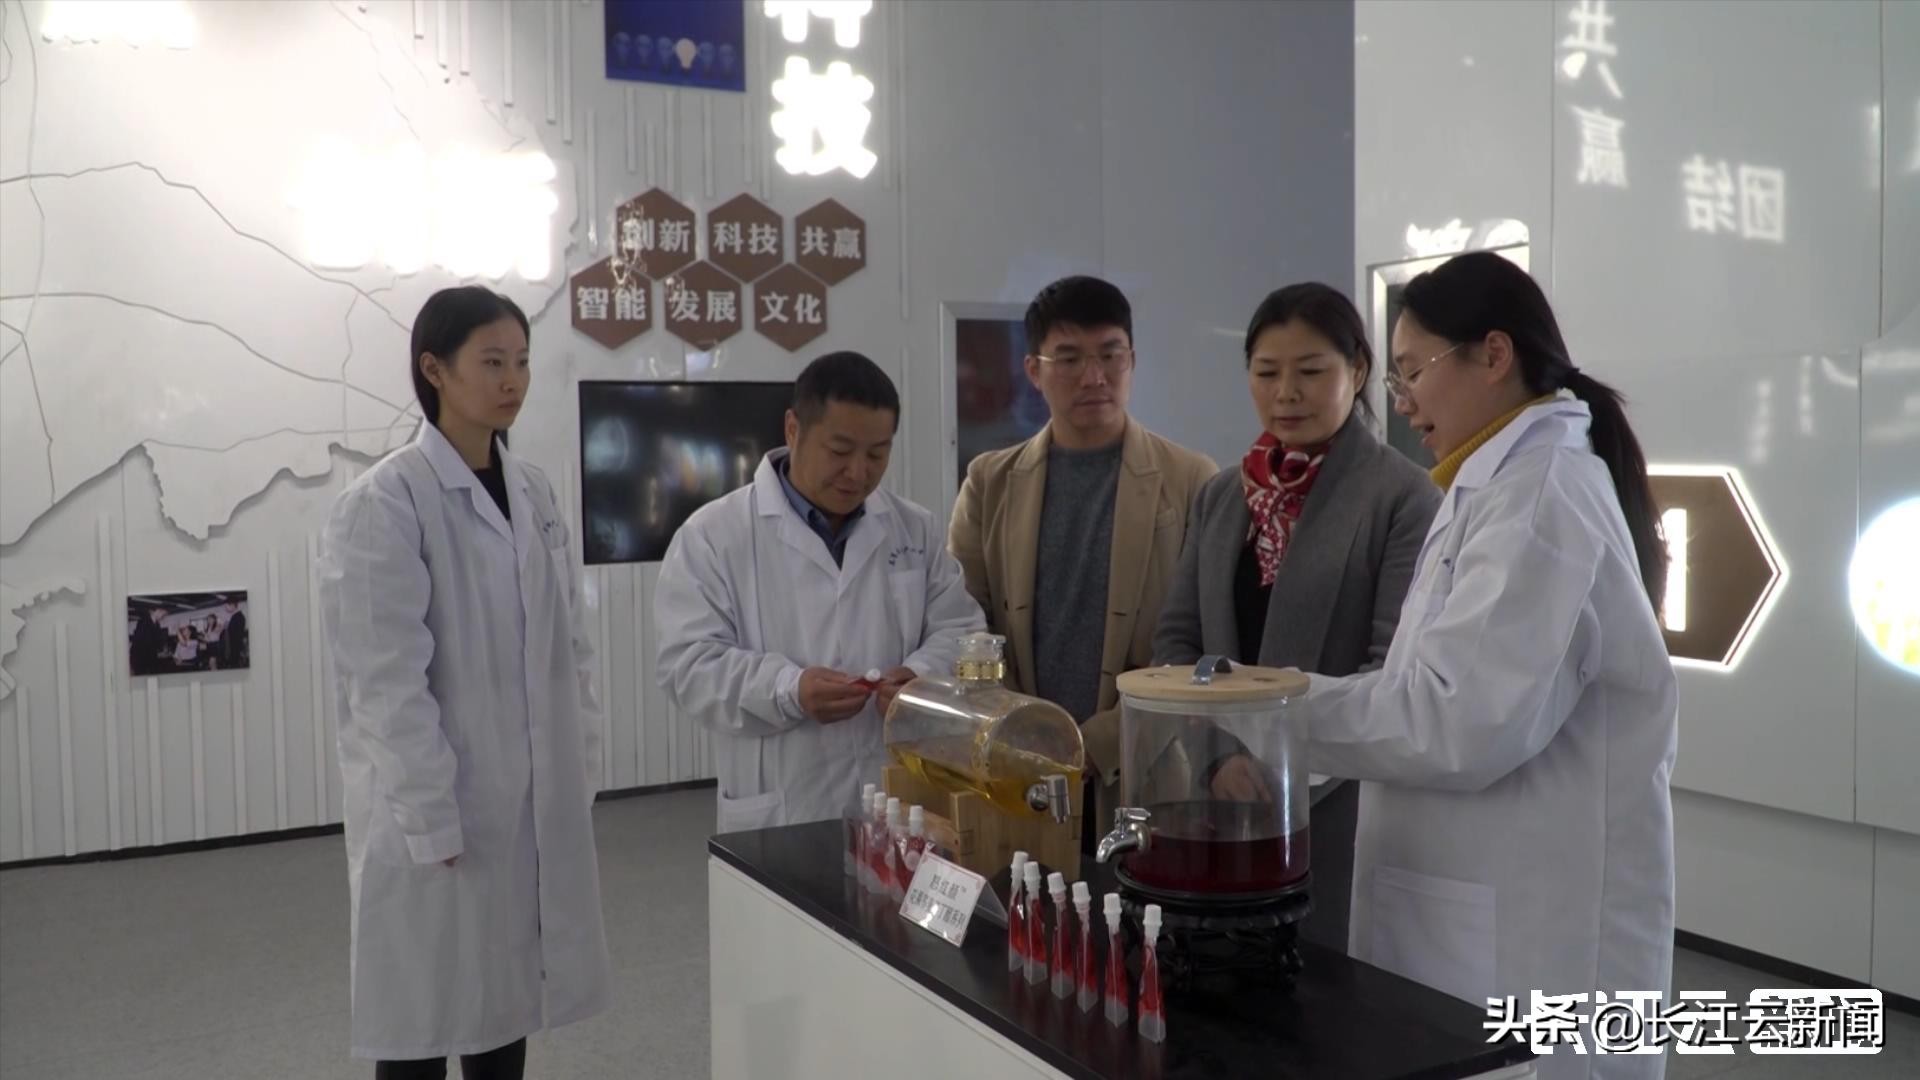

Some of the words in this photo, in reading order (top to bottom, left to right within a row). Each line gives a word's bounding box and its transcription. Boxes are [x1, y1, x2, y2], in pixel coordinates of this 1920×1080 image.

[712, 220, 779, 255] 科技
[800, 226, 863, 260] 共赢
[577, 285, 647, 321] 智能
[670, 289, 737, 323] 发展
[760, 292, 822, 325] 文化
